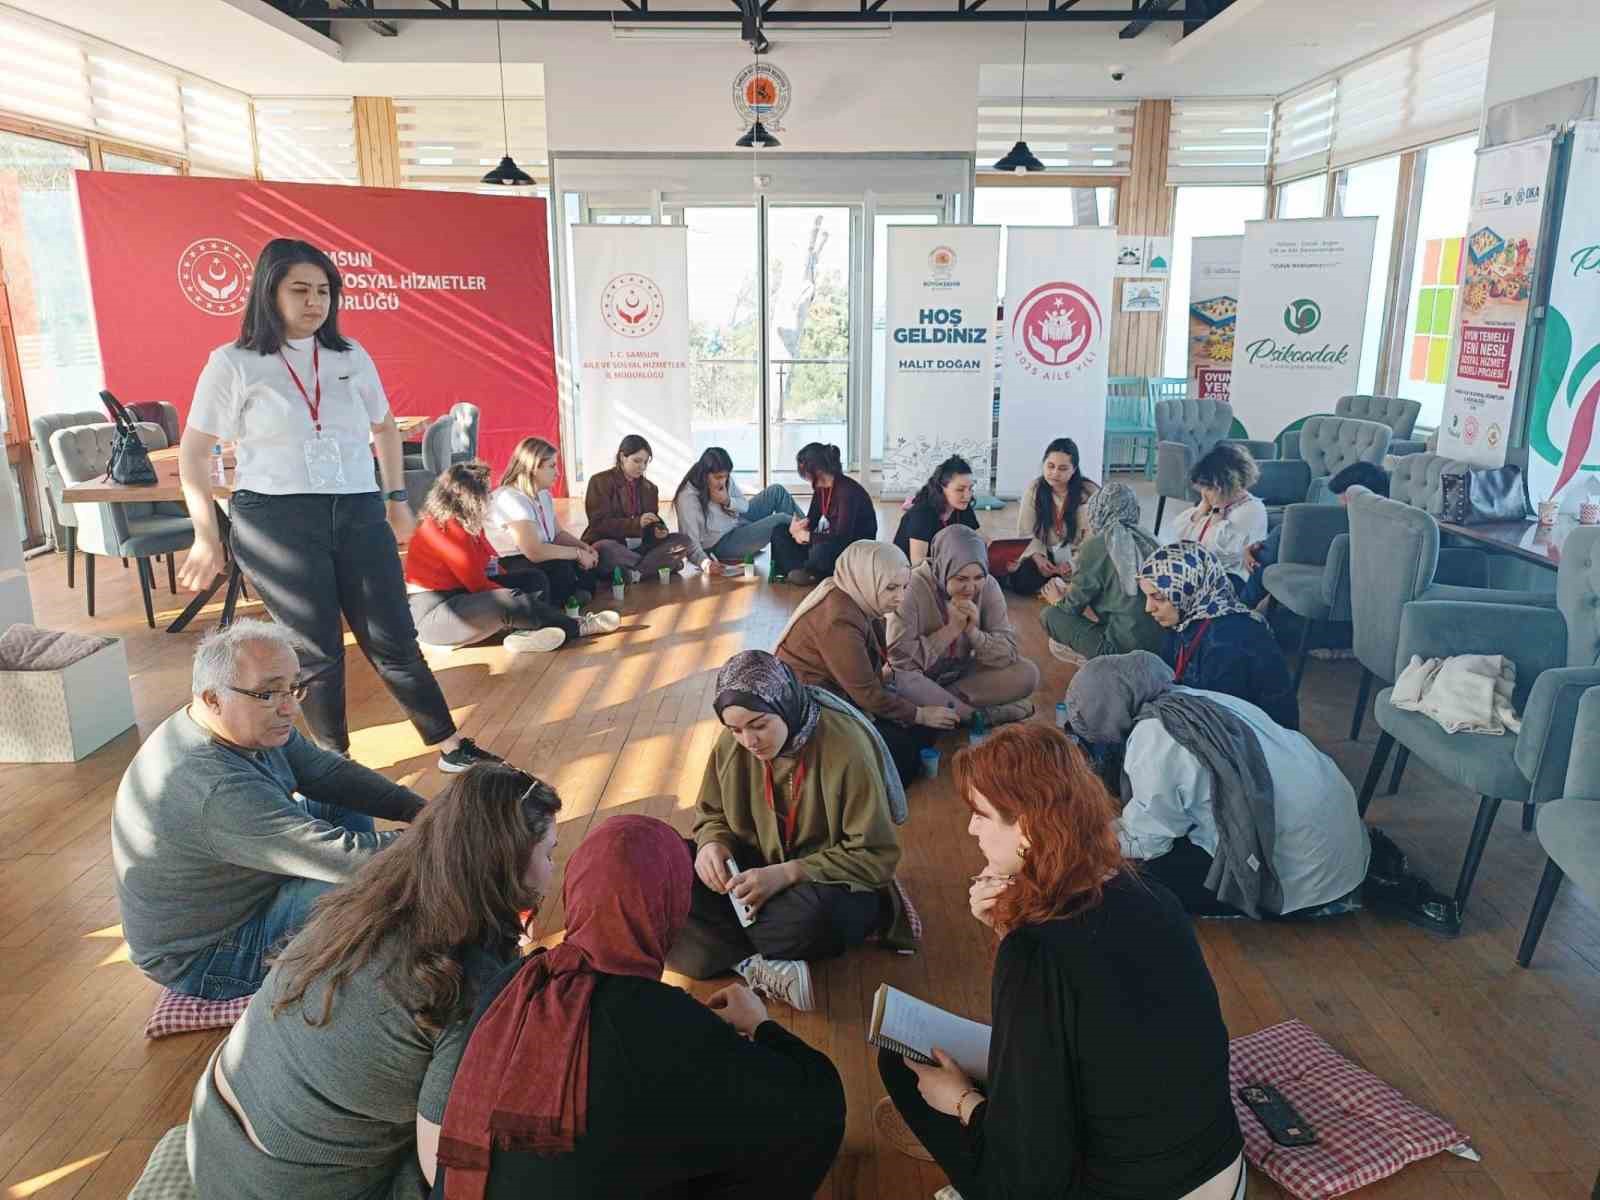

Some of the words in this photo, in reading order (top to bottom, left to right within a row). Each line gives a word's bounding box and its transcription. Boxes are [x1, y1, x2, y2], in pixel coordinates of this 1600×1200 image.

[341, 272, 398, 289] OSYAL
[400, 272, 487, 290] HİZMETLER
[919, 308, 962, 327] HOŞ
[1480, 343, 1506, 357] NESİL
[936, 358, 981, 369] DOĞAN
